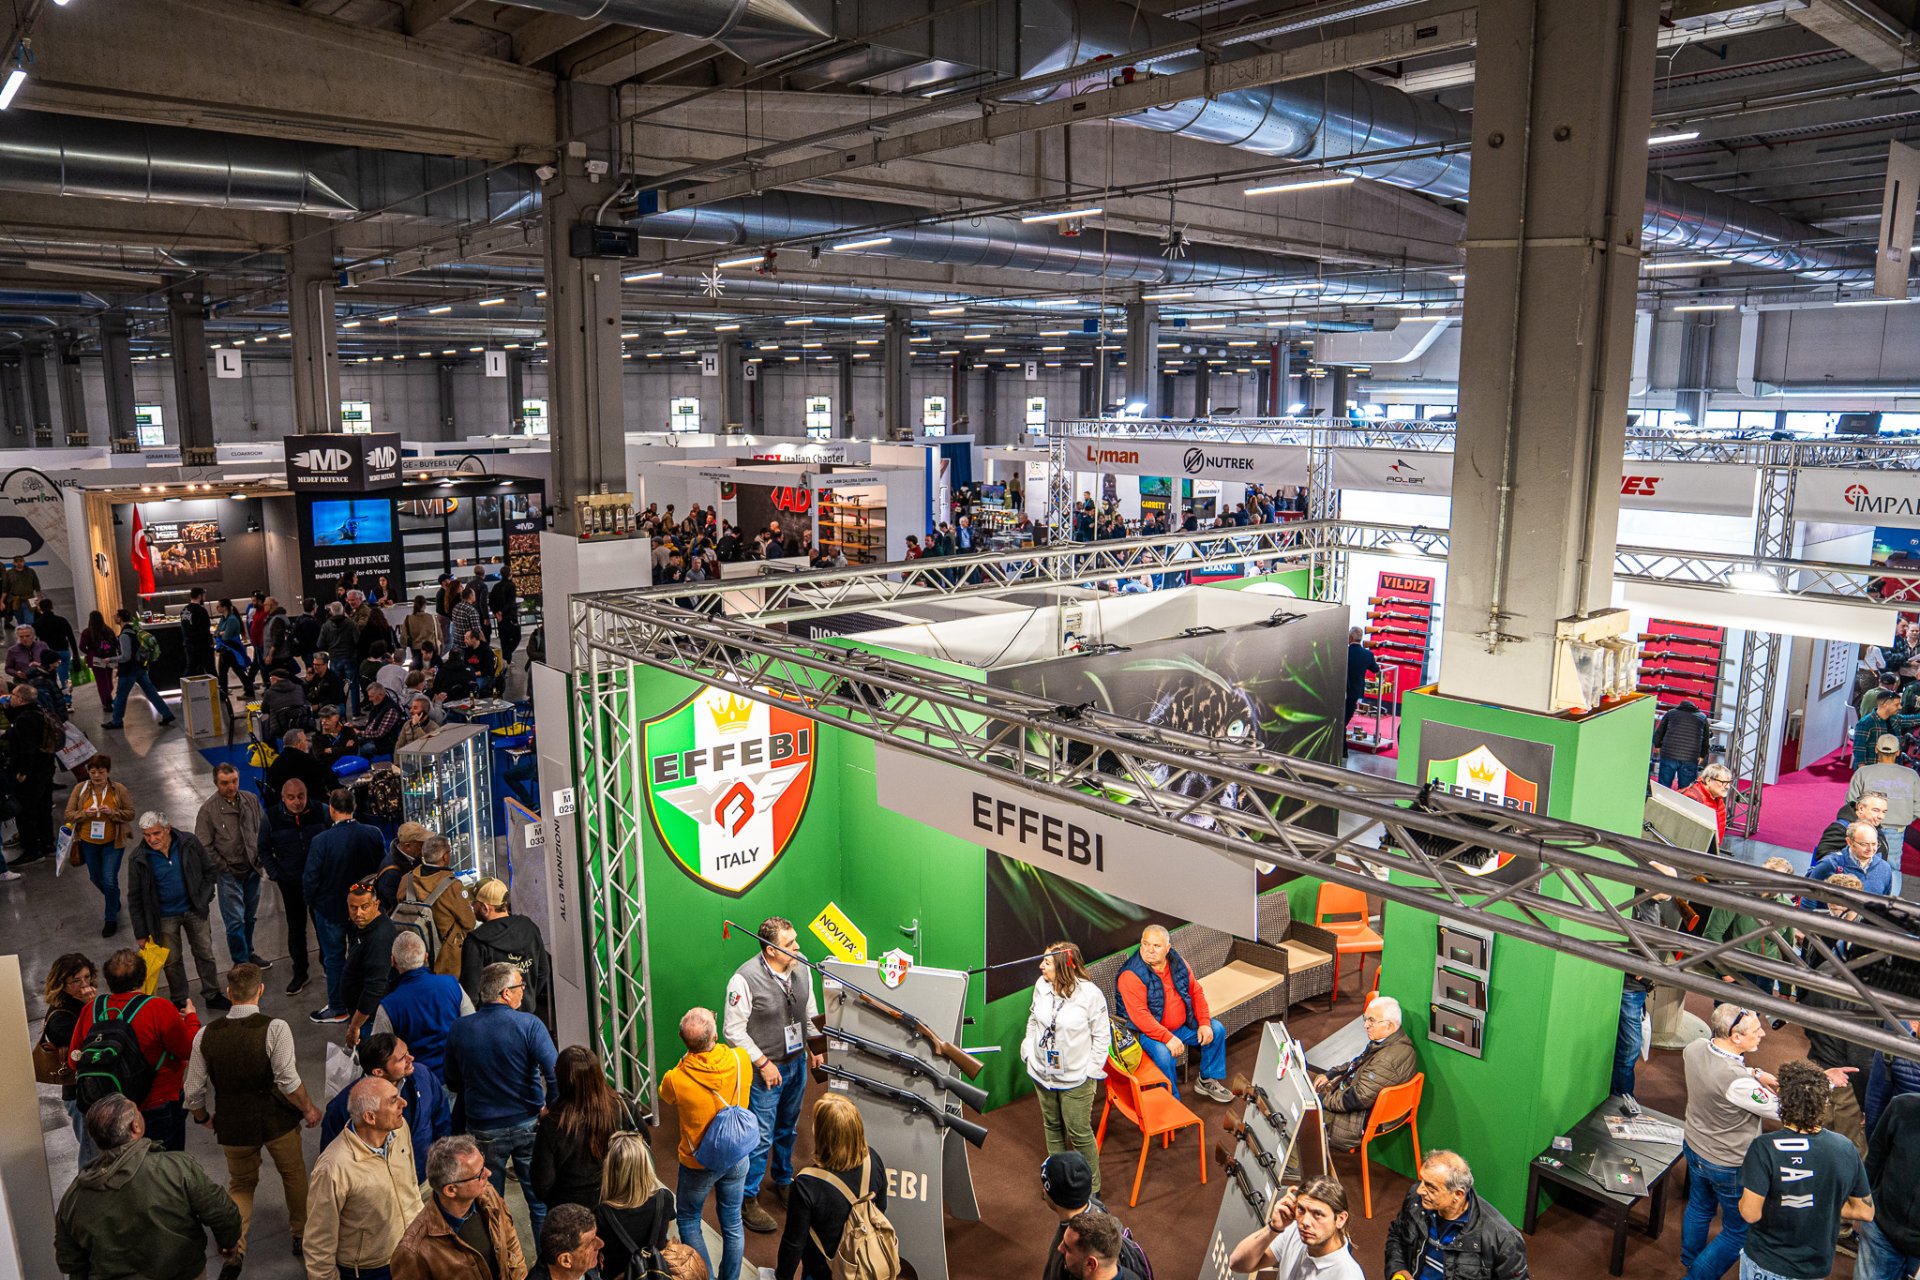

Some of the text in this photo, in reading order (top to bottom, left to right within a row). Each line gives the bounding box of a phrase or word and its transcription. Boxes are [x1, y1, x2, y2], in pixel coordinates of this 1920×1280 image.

[222, 355, 235, 371] L
[493, 356, 498, 371] I
[705, 357, 715, 371] H
[745, 365, 755, 377] G
[1028, 365, 1034, 376] F
[309, 449, 352, 470] MD
[374, 446, 397, 469] MD
[784, 455, 811, 464] Italian
[812, 454, 844, 464] Chapter
[1087, 446, 1139, 465] Lyman
[420, 459, 447, 468] BUYERS
[1206, 457, 1253, 470] NUTREK
[1620, 475, 1660, 496] ES
[1142, 500, 1166, 509] GARRETT
[315, 554, 390, 568] MEDEF DEFENCE
[1203, 563, 1233, 573] DIANA
[1383, 576, 1428, 592] YILDIZ
[653, 728, 810, 785] EFFEBI
[563, 795, 571, 803] M
[558, 804, 574, 814] 029
[534, 828, 542, 836] M
[972, 791, 1104, 872] EFFEBI
[530, 836, 545, 846] 033
[716, 847, 760, 871] ITALY
[554, 819, 567, 922] ALG MUNIZIONI
[885, 1167, 928, 1202] EBI
